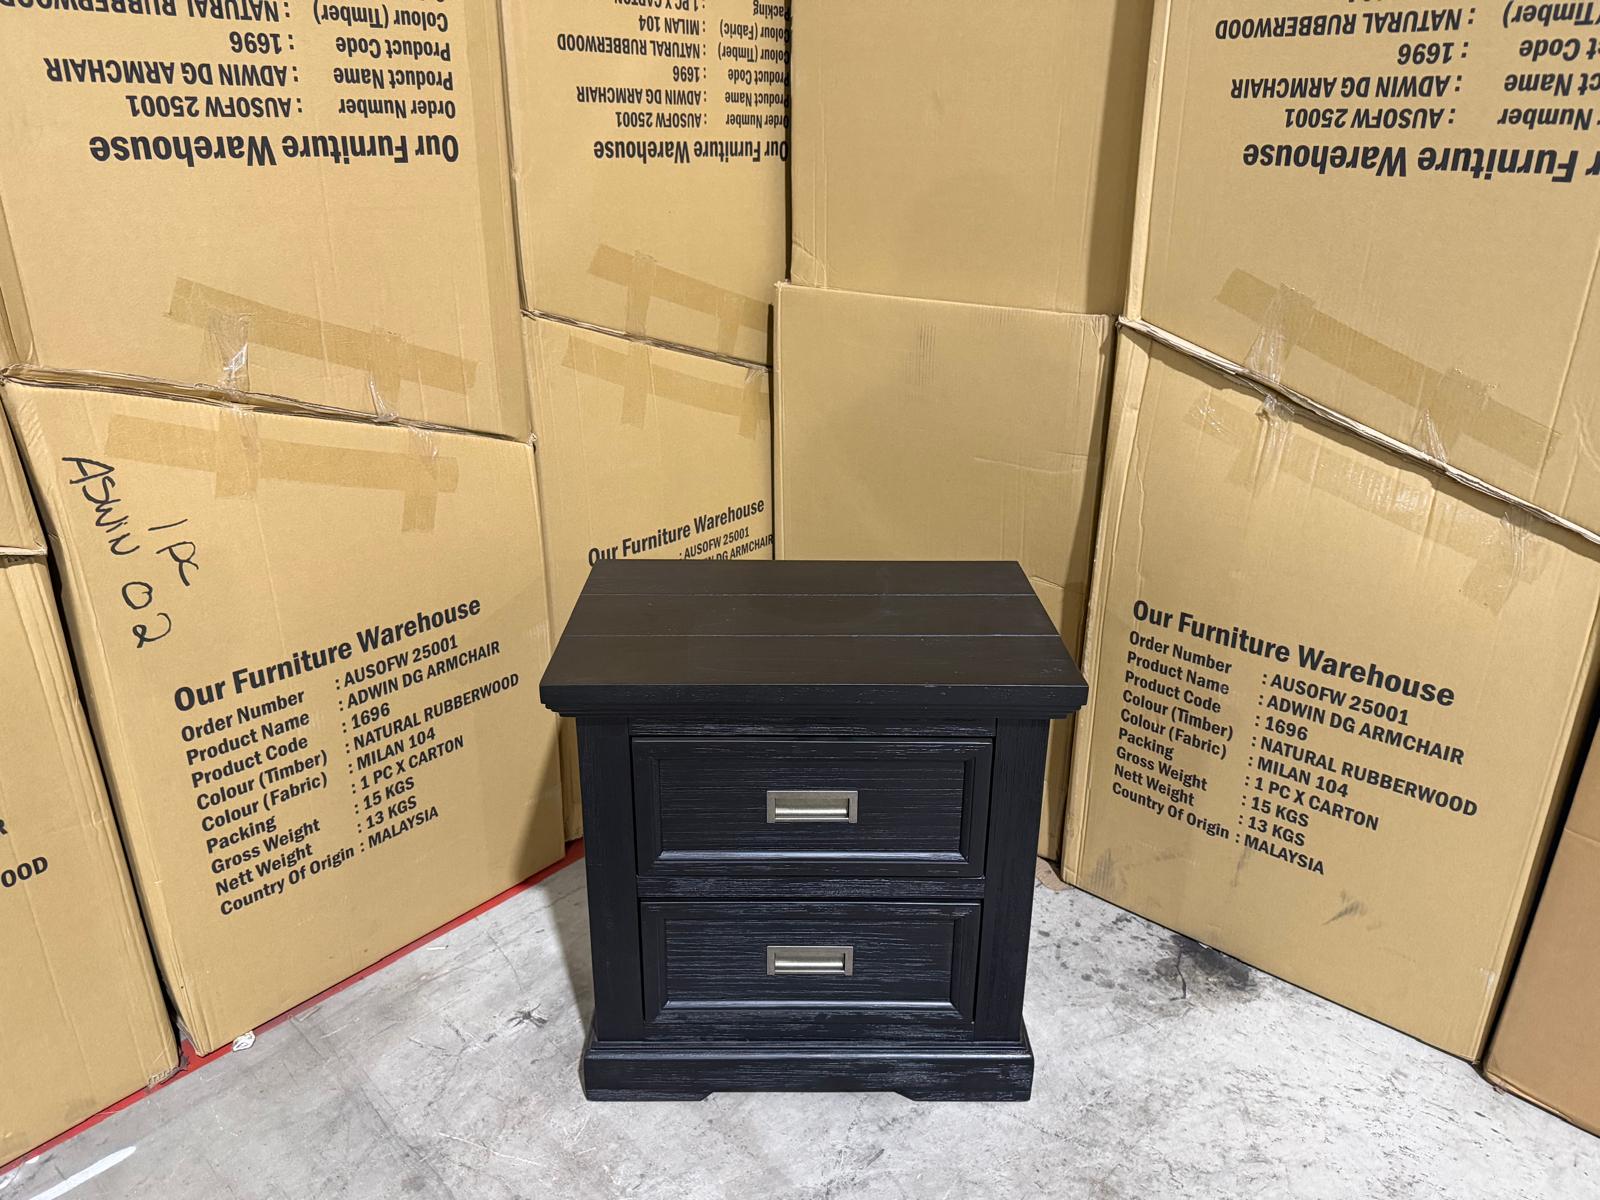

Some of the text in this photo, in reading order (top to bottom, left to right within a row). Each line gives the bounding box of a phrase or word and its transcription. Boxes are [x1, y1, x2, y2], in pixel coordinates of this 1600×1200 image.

[187, 0, 279, 22] NATURAL
[313, 0, 389, 29] (Timber)
[393, 10, 448, 32] Colour
[638, 15, 661, 32] 104
[1362, 8, 1463, 34] NATURAL
[664, 17, 699, 36] MILAN
[720, 19, 758, 41] (Fabric)
[1215, 13, 1357, 40] RUBBERWOOD
[229, 31, 451, 62] Product Code 1696
[557, 33, 647, 56] RUBBERWOOD
[649, 40, 700, 59] NATURAL
[718, 42, 758, 63] (Timber)
[1397, 42, 1455, 65] 1696
[1519, 38, 1581, 62] Code
[43, 58, 453, 91] Product Name ADWIN DG ARMCHAIR
[672, 65, 700, 83] 1696
[728, 69, 752, 85] Code
[1230, 77, 1338, 99] ARMCHAIR
[1340, 76, 1371, 98] DG
[1375, 75, 1452, 98] ADWIN
[1504, 73, 1574, 96] Name
[125, 95, 456, 119] Order Number AUSOFW 25001
[576, 86, 643, 104] ARMCHAIR
[645, 88, 662, 105] DG
[665, 89, 701, 106] ADWIN
[725, 91, 752, 107] Name
[615, 112, 653, 128] 25001
[655, 112, 702, 128] AUSOFW
[725, 114, 762, 129] Number
[1285, 108, 1593, 131] Number AUSOFW 25001
[89, 135, 459, 167] Our Furniture Warehouse
[593, 140, 789, 164] Our Furniture Warehouse
[1243, 144, 1406, 177] Warehouse
[1417, 147, 1579, 183] Furniture
[622, 524, 691, 557] Furniture
[693, 500, 764, 534] Warehouse
[684, 526, 749, 559] AUSOFW 25001
[122, 581, 172, 649] 02
[174, 600, 480, 711] Our Furniture Warehouse
[1133, 600, 1454, 706] Our Furniture Warehouse
[181, 634, 458, 742] Order Number AUSOFW 25001
[1129, 630, 1408, 726] Order Number AUSOFW 25001
[186, 641, 500, 766] Product Name ADWIN DG ARMCHAIR
[1125, 670, 1308, 741] Product Code 1696
[1127, 650, 1464, 765] Product Name ADWIN DG ARMCHAIR
[191, 702, 390, 788] Product Code 1696
[197, 673, 519, 810] Colour (Timber) NATURAL RUBBERWOOD
[1121, 708, 1348, 798] Colour (Fabric) MILAN 104
[1123, 690, 1477, 816] Colour (Timber) NATURAL RUBBERWOOD
[202, 727, 436, 832] Colour (Fabric) MILAN 104
[1116, 746, 1309, 827] Gross Weight 15 KGS
[1118, 727, 1379, 831] Packing 1 PC X CARTON
[206, 735, 464, 854] Packing 1 PC X CARTON
[1114, 763, 1305, 847] Nett Weight 13 KGS
[211, 776, 415, 874] Gross Weight 15 KGS
[1112, 782, 1324, 875] Country Of Origin MALAYSIA
[215, 795, 417, 896] Nett Weight 13 KGS
[220, 806, 439, 915] Country Of Origin MALAYSIA
